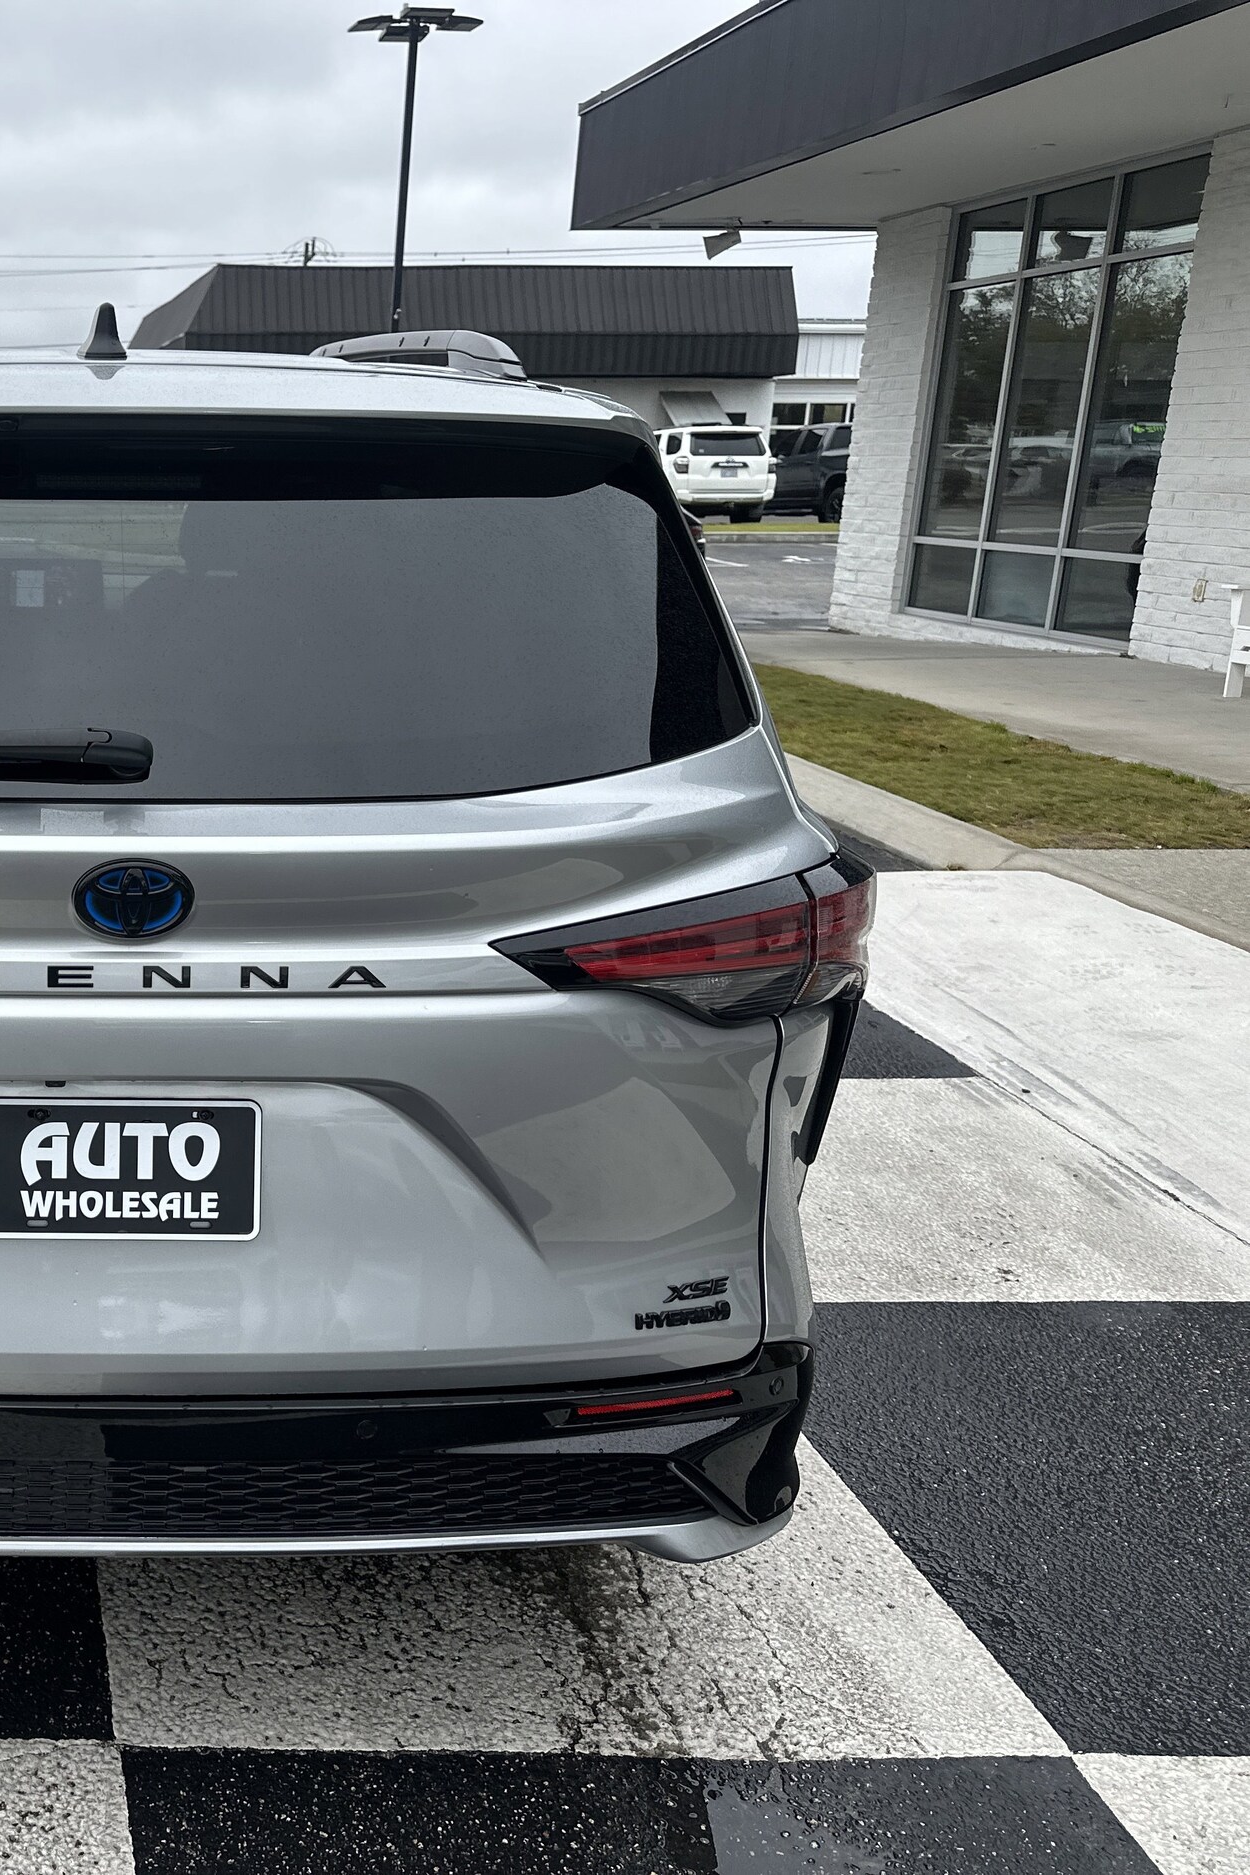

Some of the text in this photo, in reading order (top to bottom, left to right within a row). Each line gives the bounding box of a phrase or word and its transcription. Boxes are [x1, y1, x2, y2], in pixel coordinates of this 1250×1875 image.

[20, 1122, 221, 1186] AUTO
[20, 1190, 220, 1222] WHOLESALE
[662, 1276, 730, 1303] XSE
[635, 1304, 715, 1331] HYBRID
